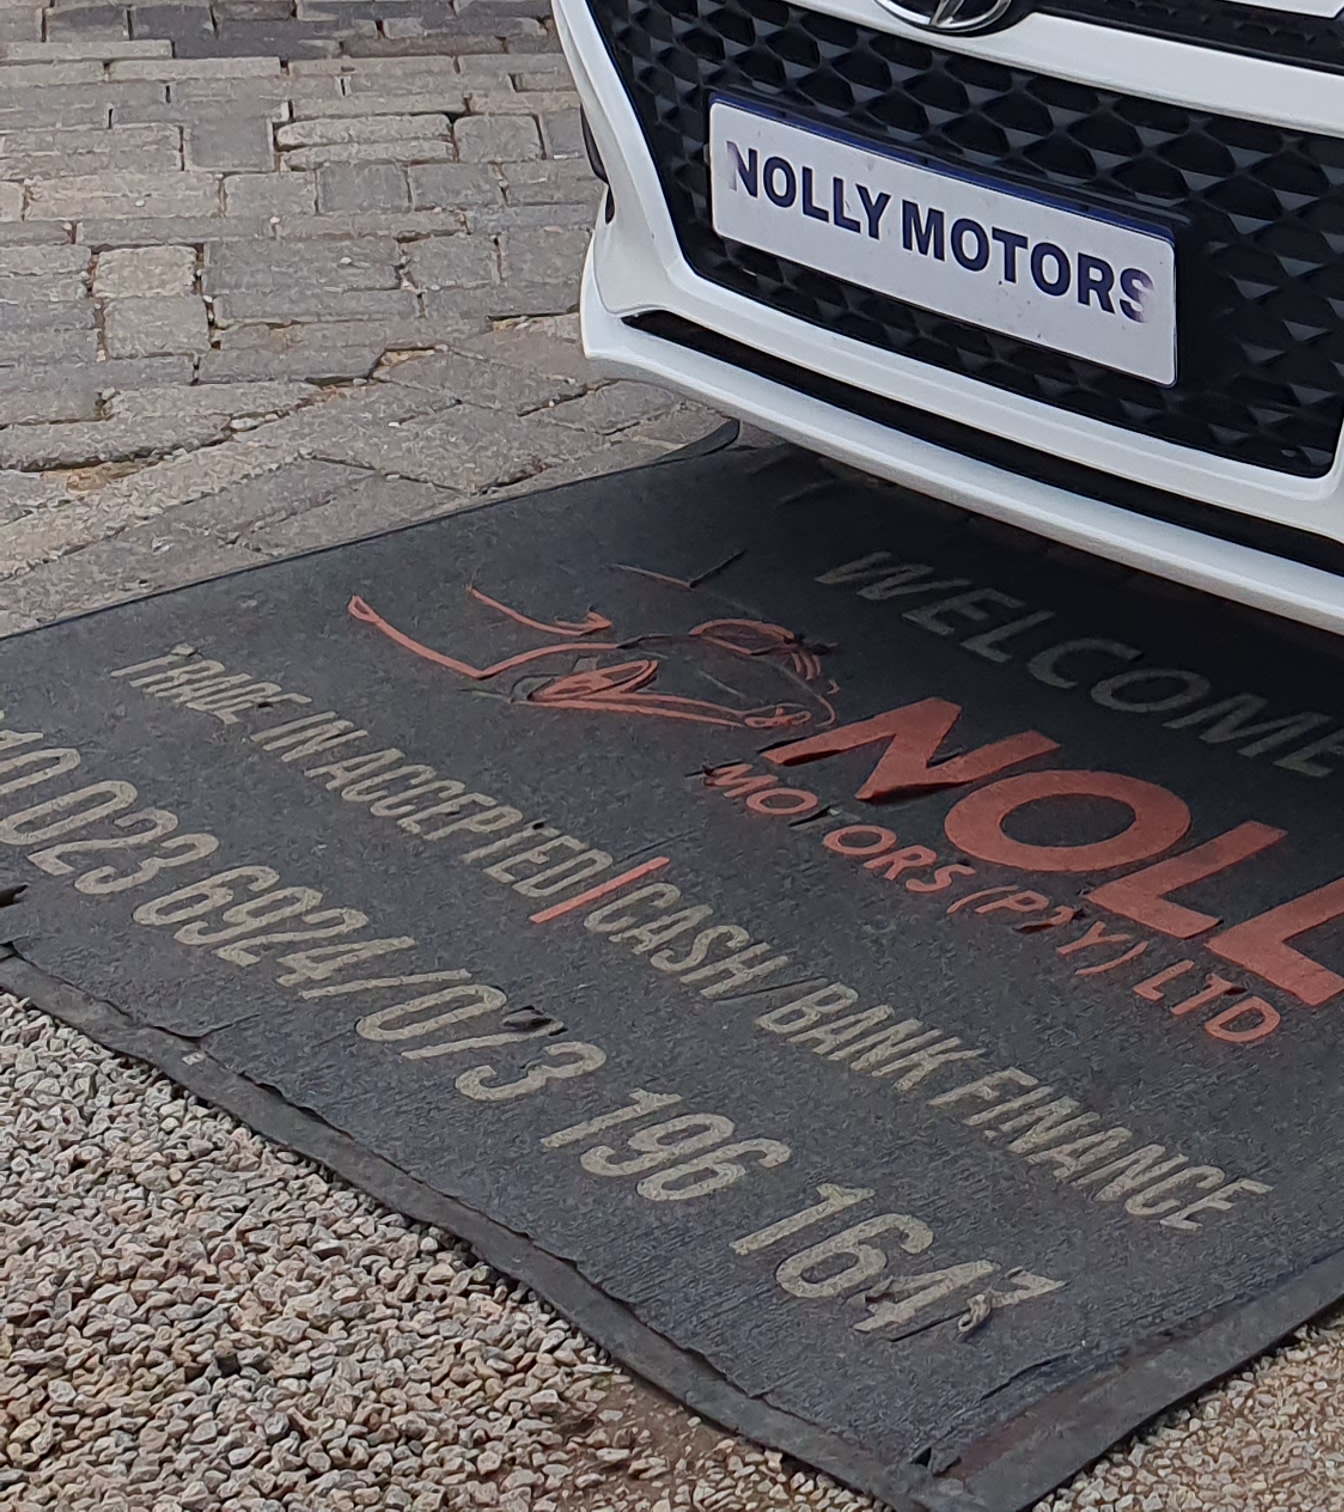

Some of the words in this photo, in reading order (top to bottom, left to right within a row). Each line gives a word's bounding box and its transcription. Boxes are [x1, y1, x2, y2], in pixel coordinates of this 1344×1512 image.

[725, 139, 891, 240] NOLLY
[901, 199, 1156, 324] MOTORS
[110, 643, 312, 725] TRADE
[928, 1066, 1275, 1230] FINANCE
[703, 763, 976, 892] MOTORS
[1132, 959, 1281, 1043] LTD
[540, 1089, 791, 1201] 196
